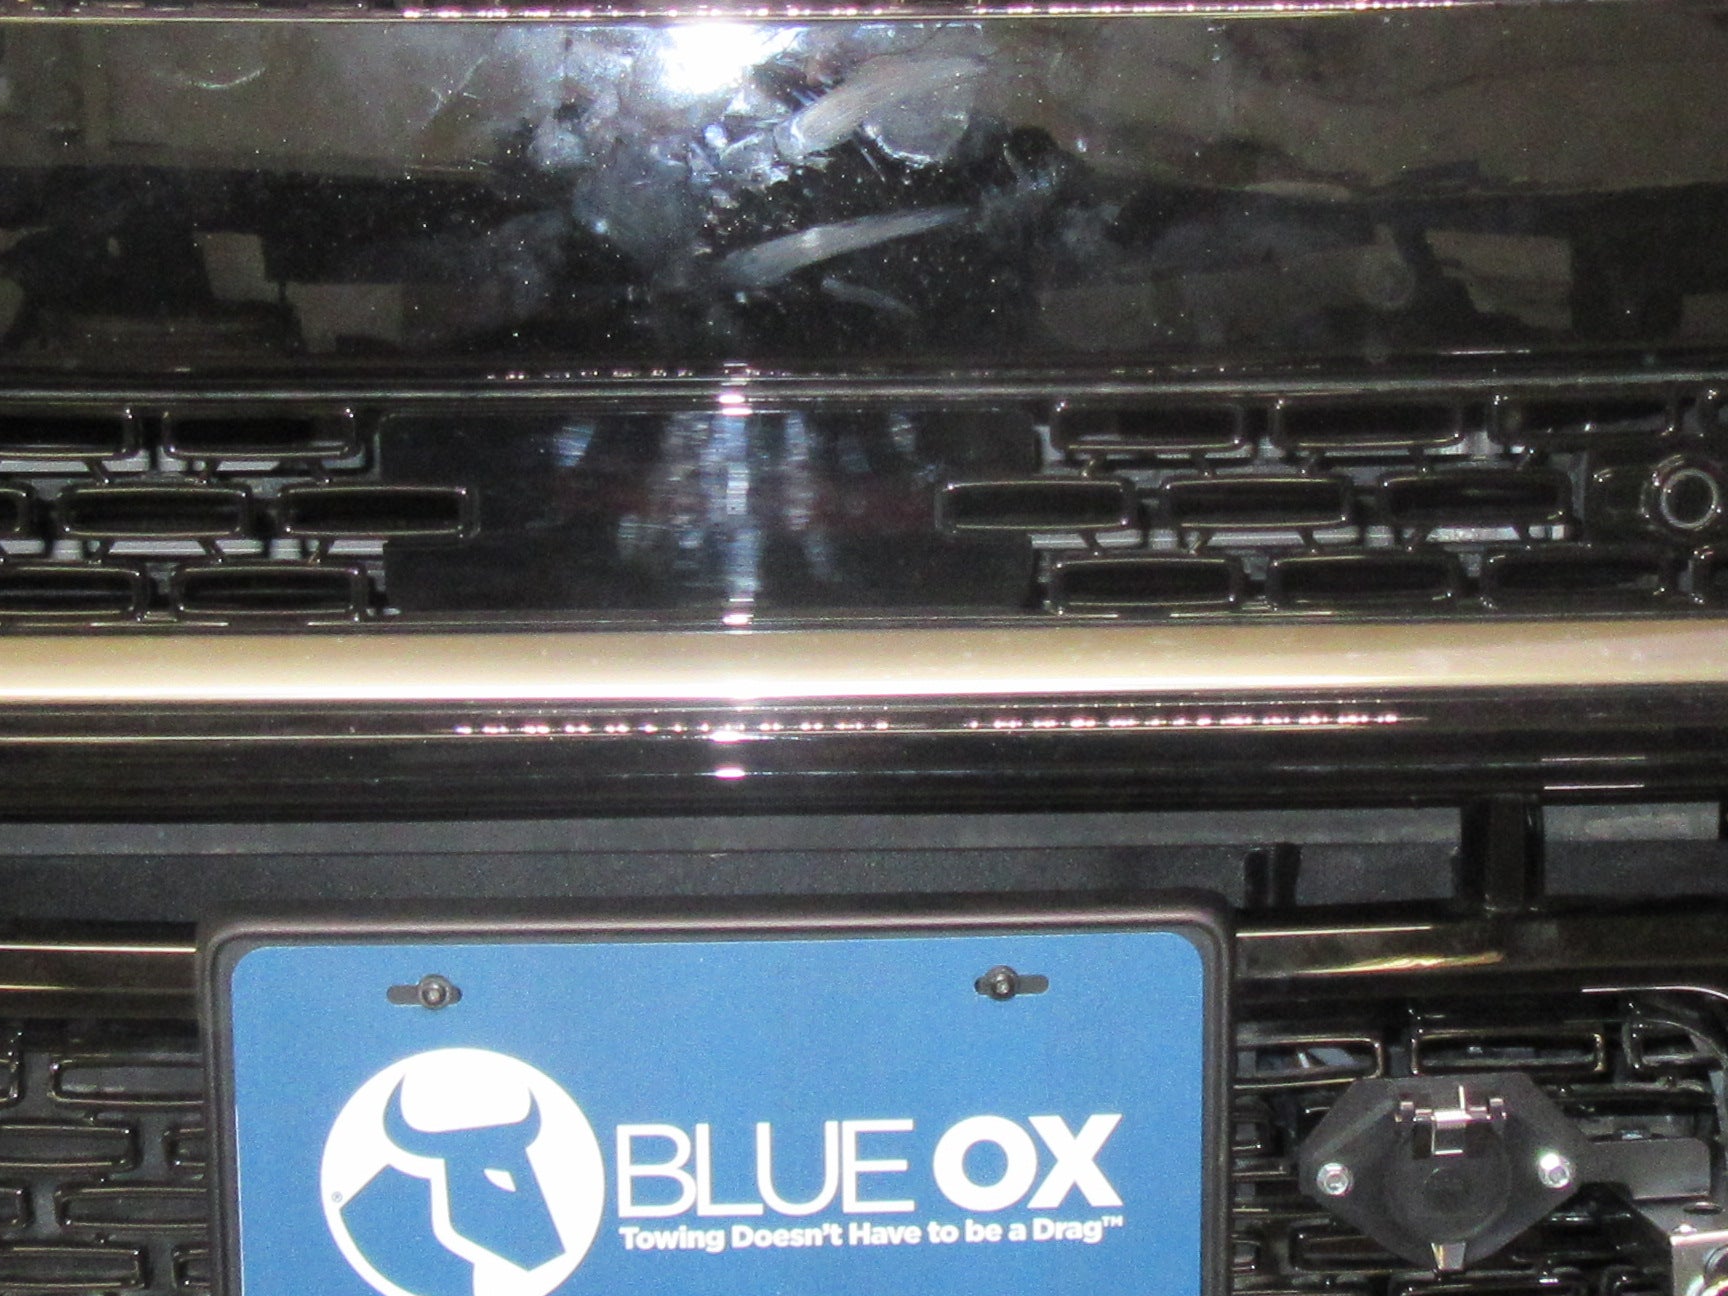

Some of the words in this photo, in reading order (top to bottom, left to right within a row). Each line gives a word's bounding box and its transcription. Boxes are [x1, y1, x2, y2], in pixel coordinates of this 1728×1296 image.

[616, 1119, 916, 1219] BLUE
[932, 1113, 1124, 1212] OX
[618, 1225, 726, 1253] Towing
[731, 1222, 843, 1248] Doesn't
[849, 1221, 922, 1246] Have
[926, 1221, 960, 1244] to
[965, 1219, 1004, 1243] be
[1007, 1221, 1027, 1241] a
